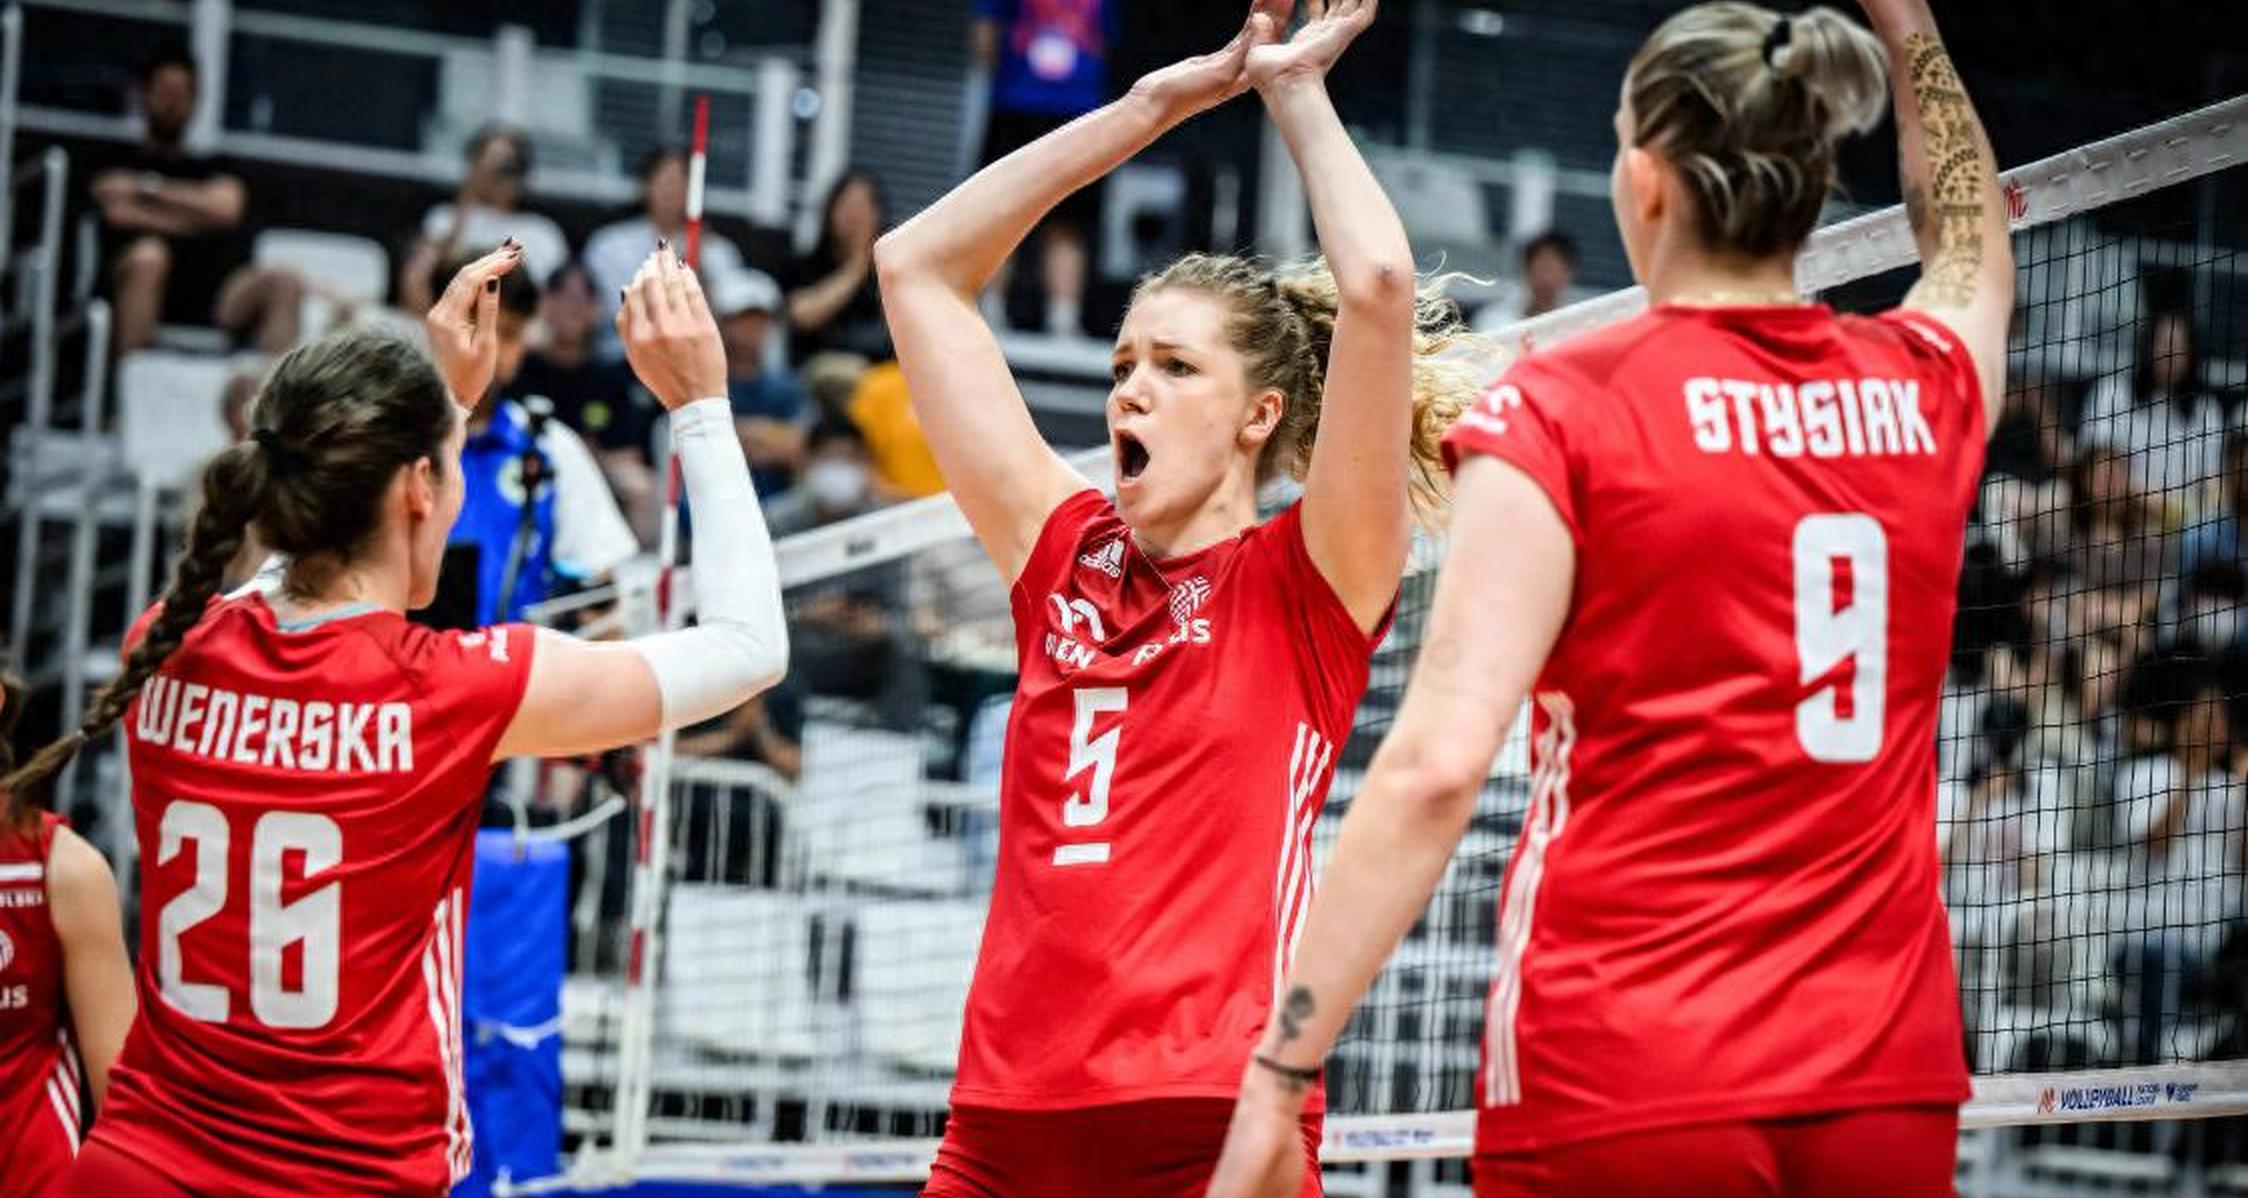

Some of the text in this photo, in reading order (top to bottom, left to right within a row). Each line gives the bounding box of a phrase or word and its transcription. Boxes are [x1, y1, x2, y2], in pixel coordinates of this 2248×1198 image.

[1683, 376, 1937, 459] STYSIAK
[1079, 553, 1121, 578] adidas
[1792, 511, 1889, 763] 9
[136, 676, 415, 773] WENERSKA
[1063, 686, 1129, 828] 5
[156, 799, 343, 1030] 26
[2060, 1084, 2134, 1110] VOLLEYBALL
